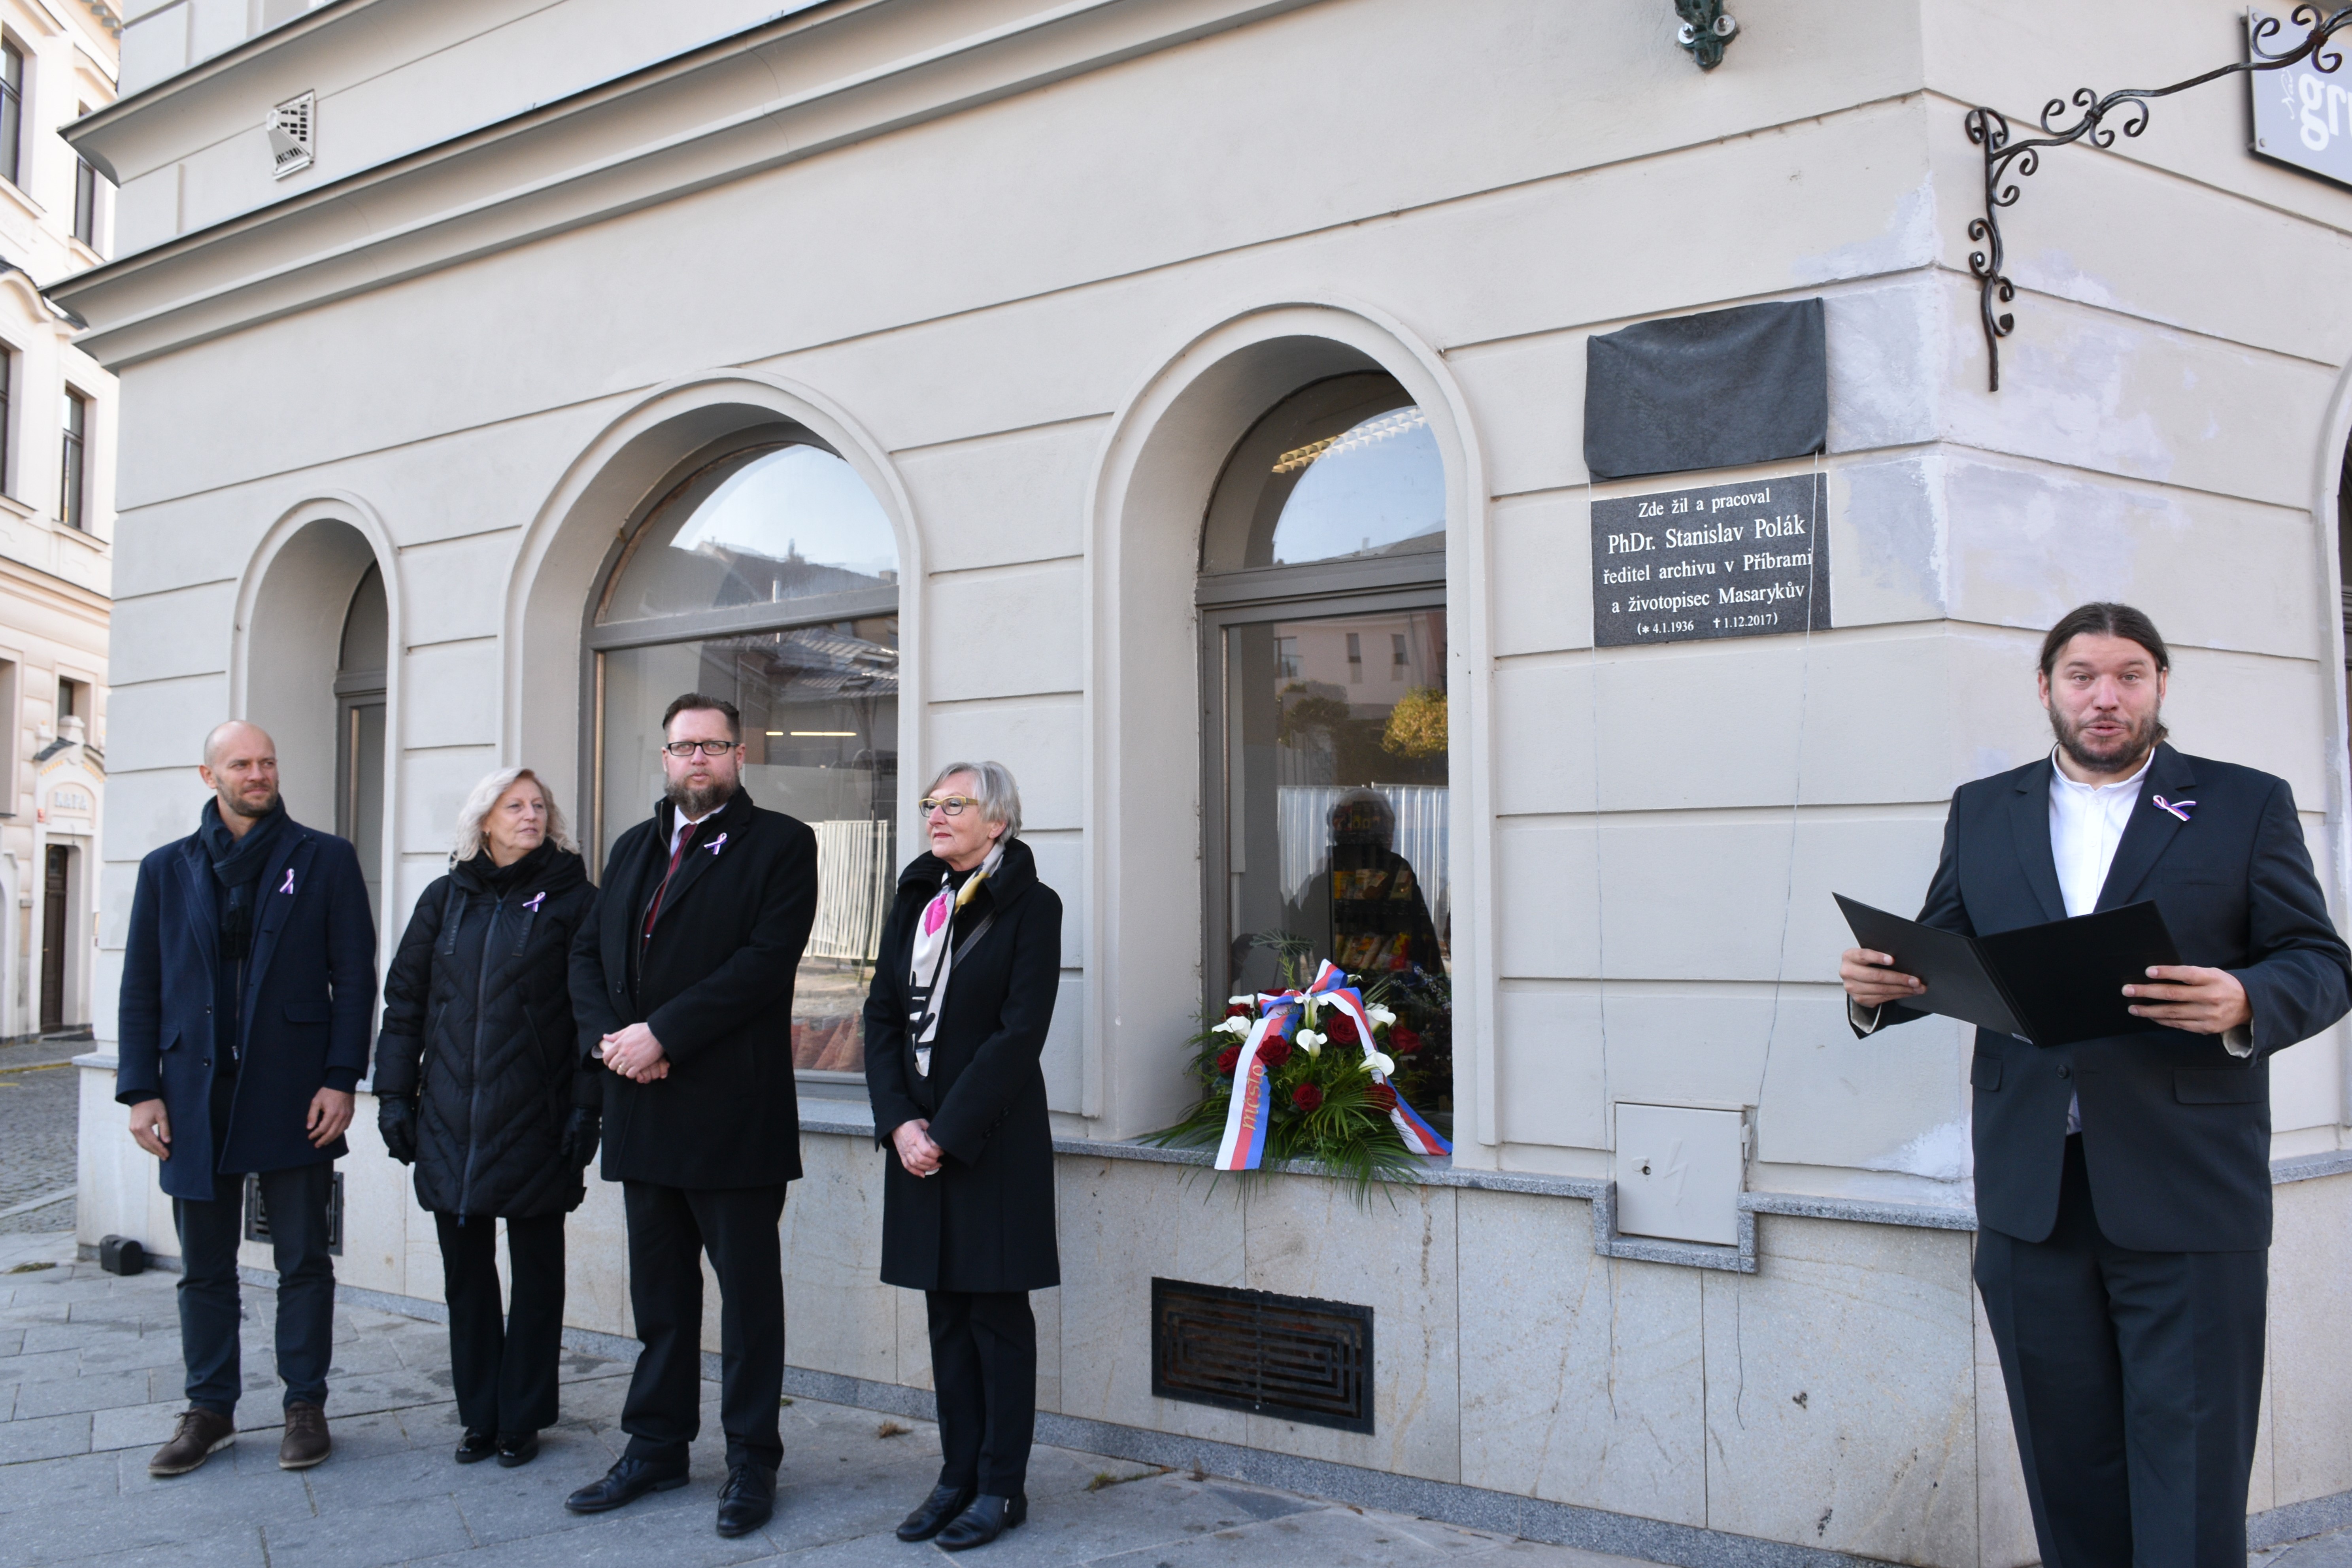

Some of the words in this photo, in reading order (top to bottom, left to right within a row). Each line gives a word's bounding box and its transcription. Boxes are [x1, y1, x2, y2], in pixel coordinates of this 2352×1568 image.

[2298, 74, 2352, 151] gr
[1638, 502, 1664, 517] Zde
[1671, 498, 1688, 515] žil
[1696, 500, 1705, 511] a
[1710, 486, 1772, 511] pracoval
[1608, 532, 1655, 554] PhDr.
[1665, 522, 1744, 548] Stanislav
[1754, 513, 1806, 540] Polák
[1603, 564, 1650, 584] ředitel
[1659, 560, 1716, 579] archivu
[1724, 561, 1734, 572] v
[1743, 547, 1812, 572] Příbrami
[1612, 602, 1620, 613] a
[1628, 592, 1710, 612] životopisec
[1718, 581, 1805, 604] Masarykův
[1242, 1064, 1265, 1130] město
